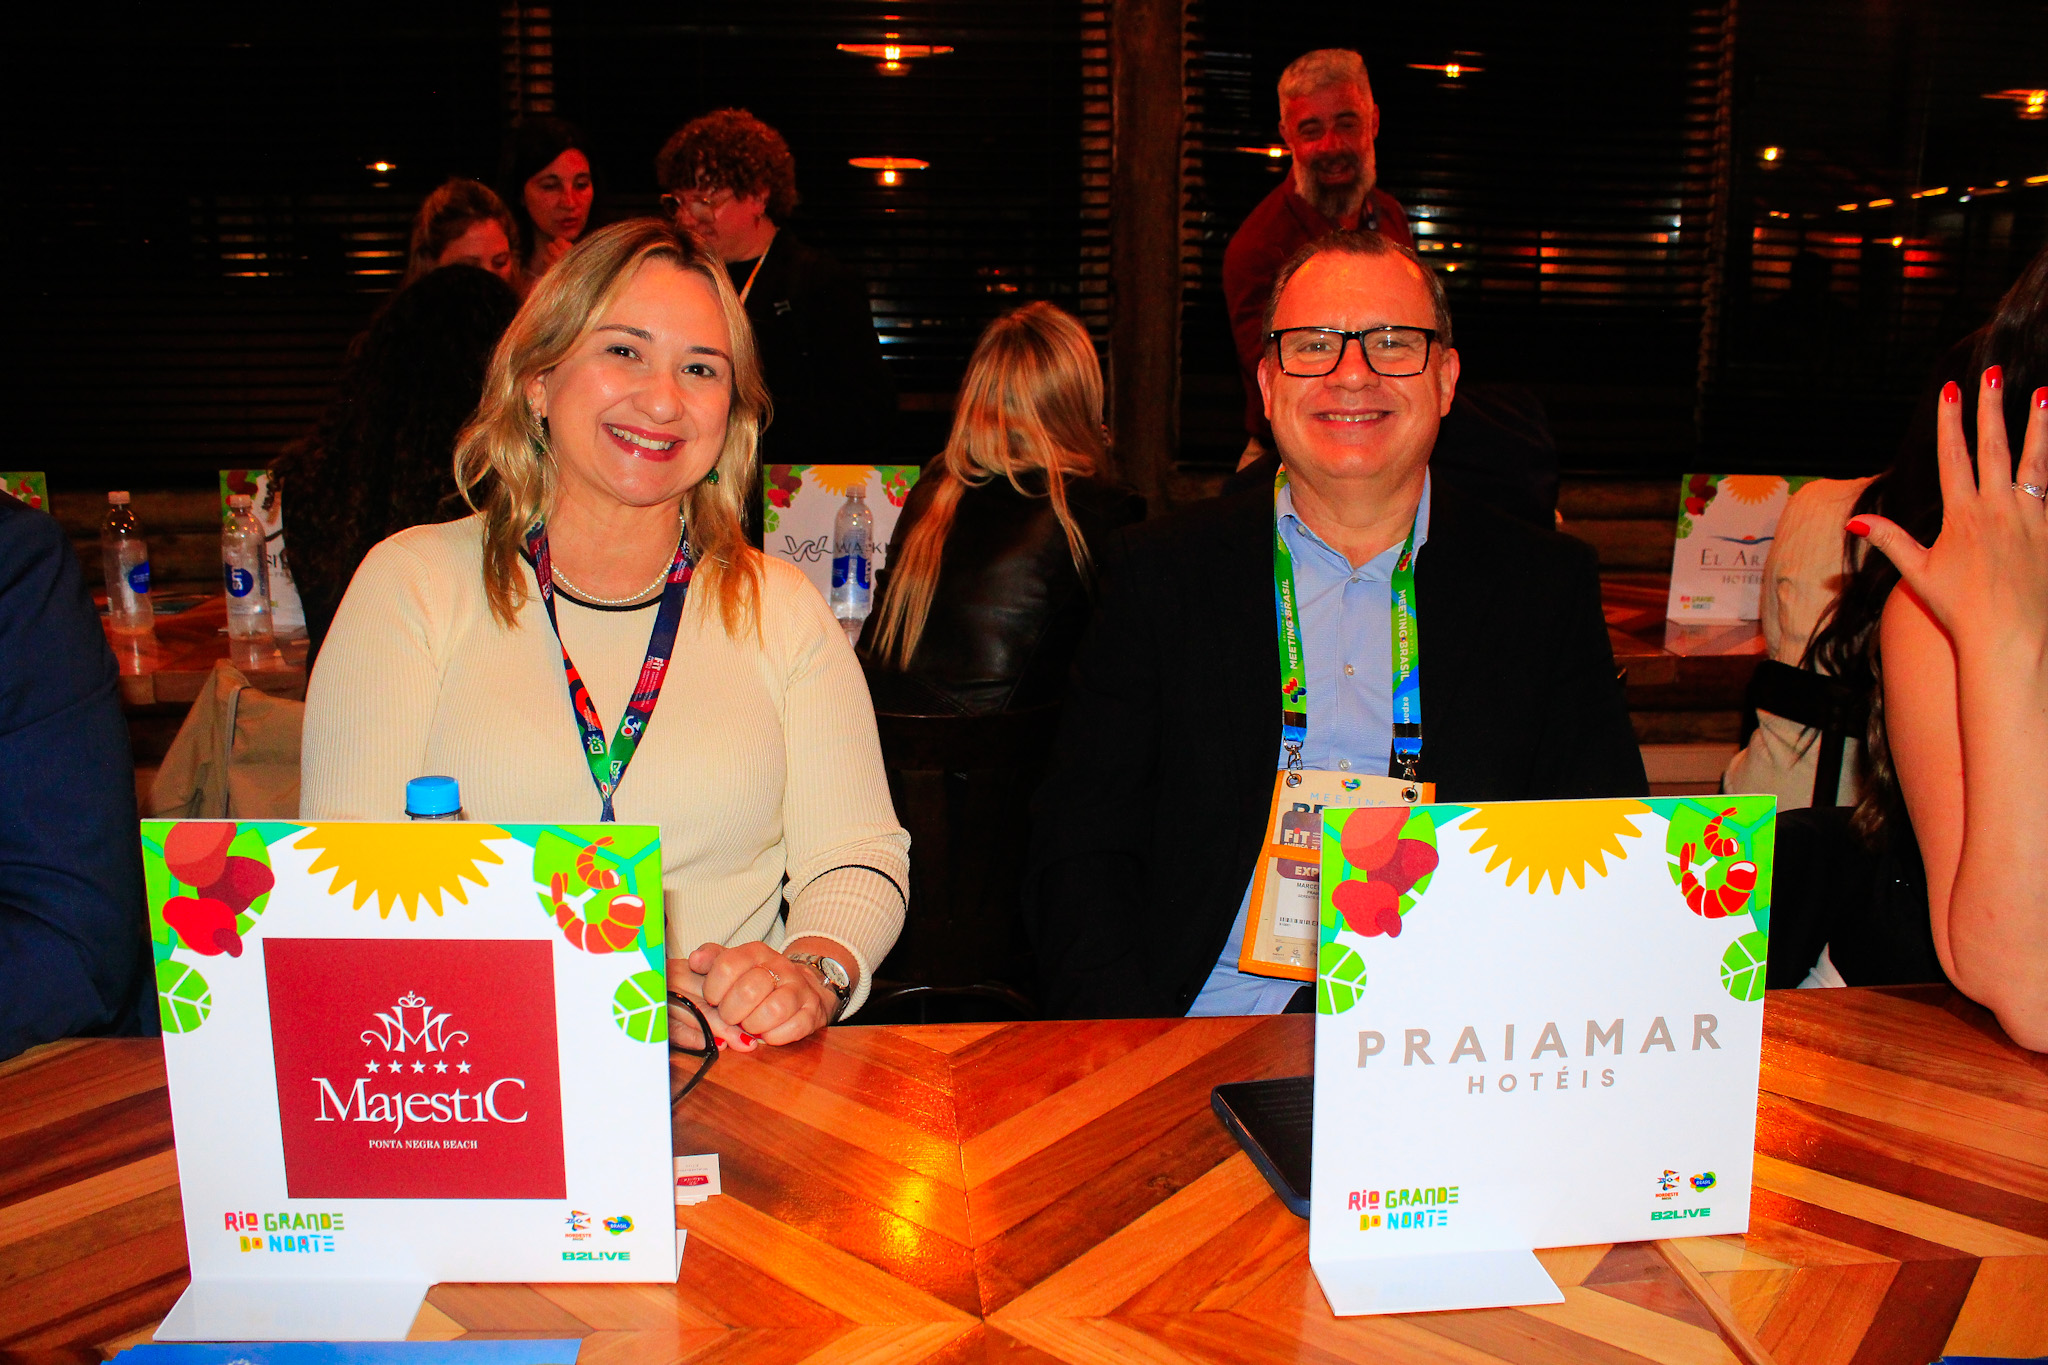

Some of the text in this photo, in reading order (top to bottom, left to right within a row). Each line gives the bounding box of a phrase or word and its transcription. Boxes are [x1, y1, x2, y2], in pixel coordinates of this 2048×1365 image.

[1357, 1013, 1722, 1069] PRAIAMAR
[1467, 1066, 1616, 1095] HOTÉIS
[368, 1139, 478, 1149] PONTA NEGRA BEACH
[1385, 1186, 1459, 1209] GRANDE
[263, 1212, 345, 1232] GRANDE
[1387, 1209, 1448, 1230] NORTE
[268, 1234, 335, 1253] NORTE
